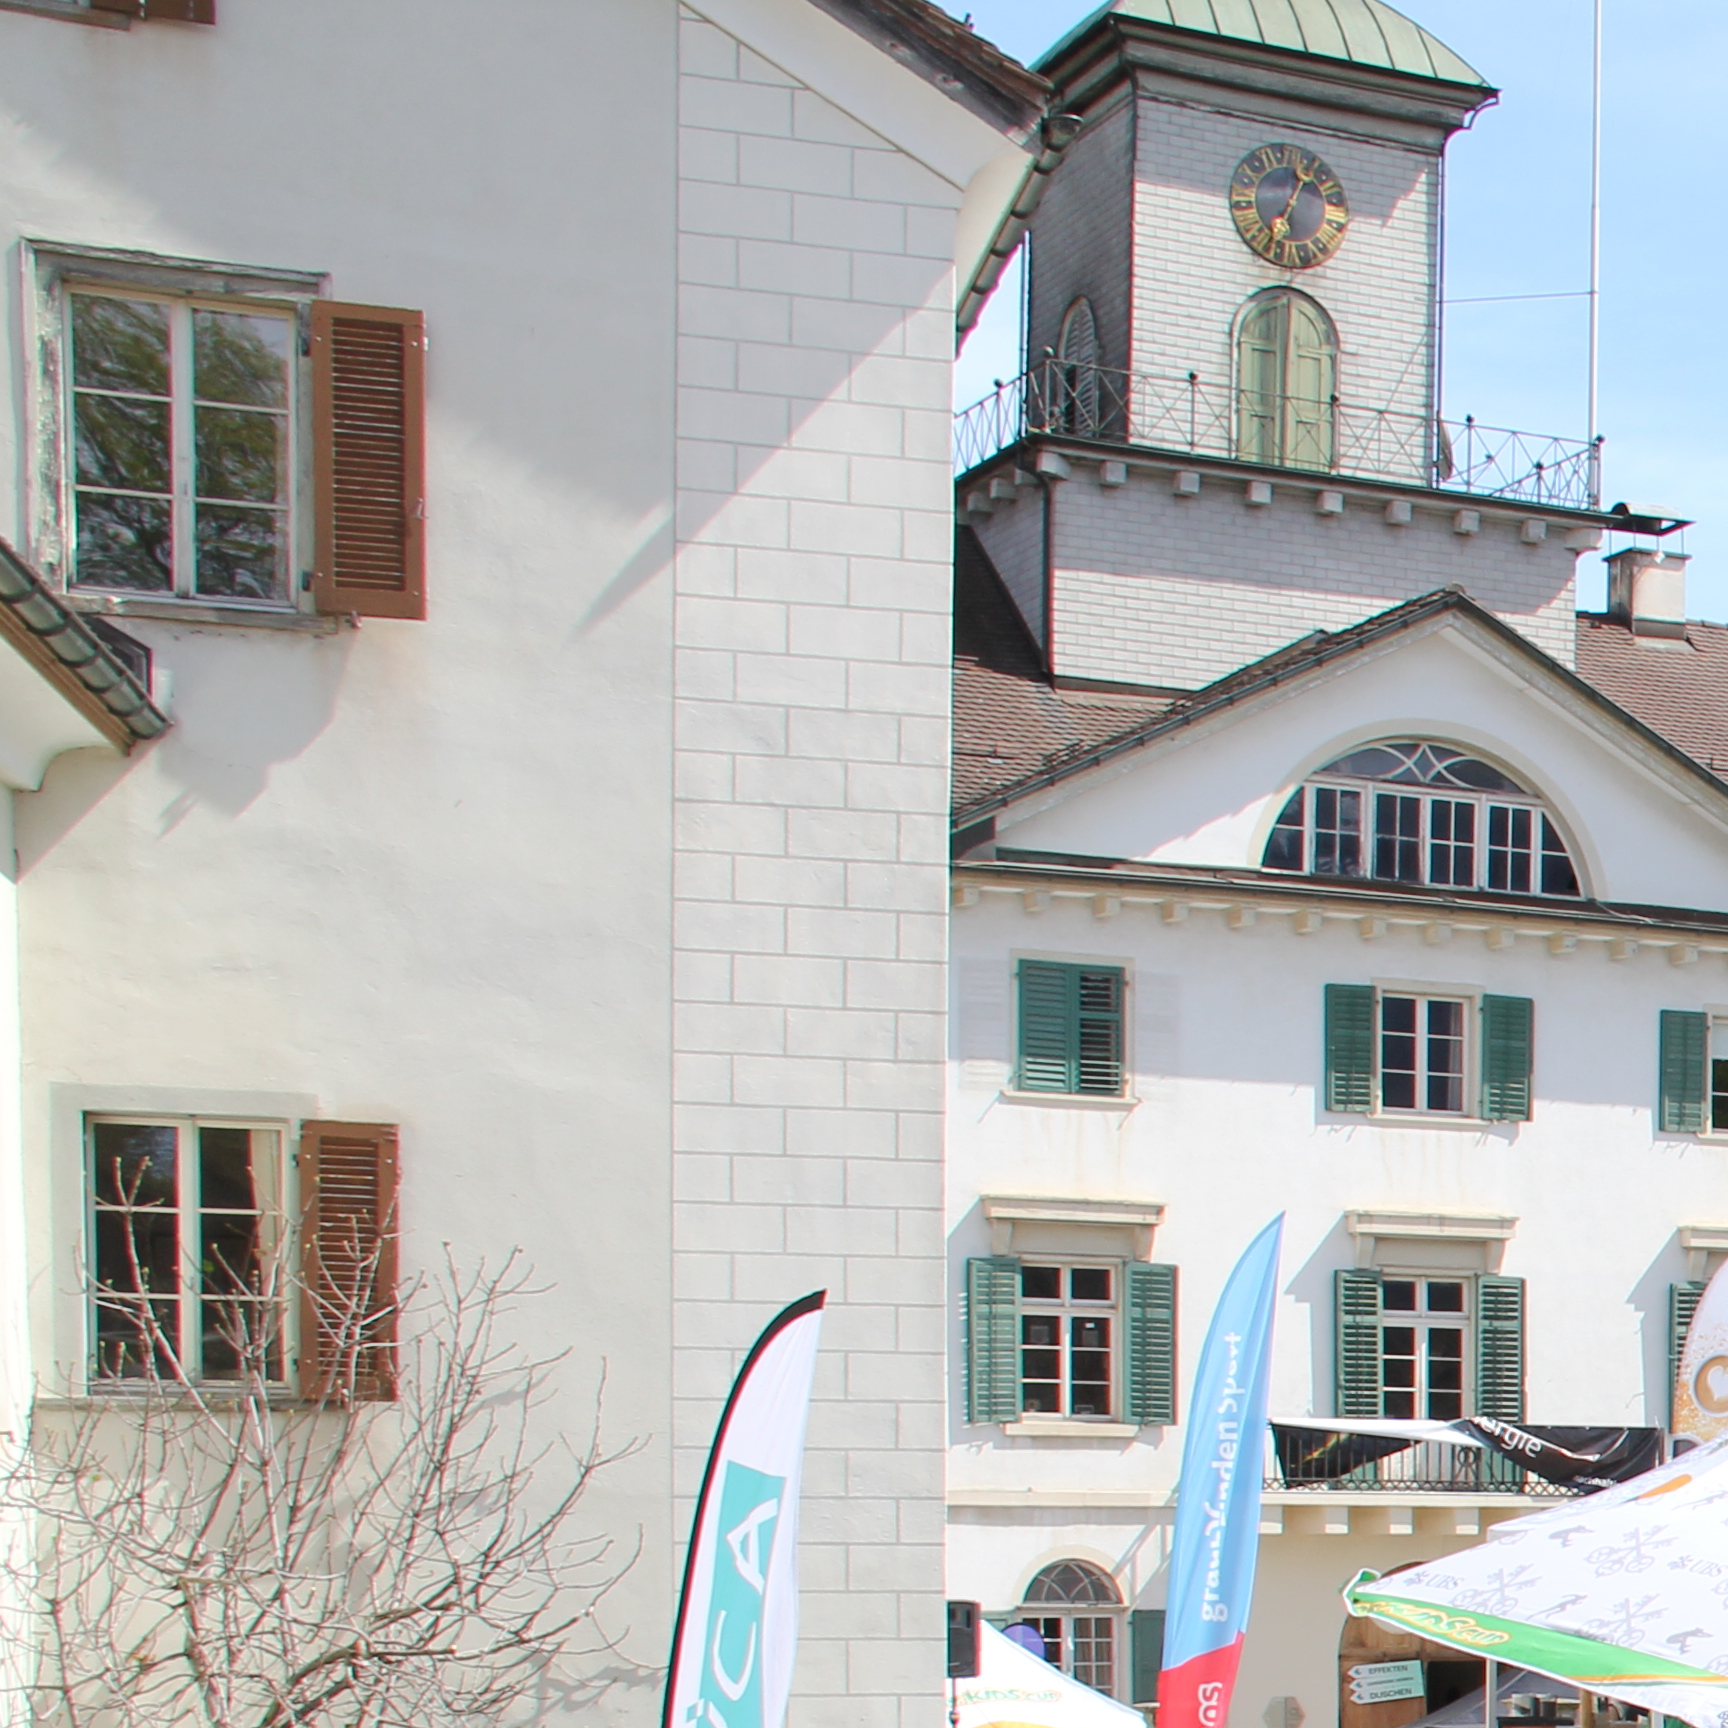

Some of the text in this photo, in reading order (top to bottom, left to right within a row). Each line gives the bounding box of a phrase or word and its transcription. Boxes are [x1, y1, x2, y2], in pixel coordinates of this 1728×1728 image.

[1475, 1416, 1542, 1459] ergie
[1368, 1665, 1408, 1675] EFFEKTEN
[1369, 1687, 1413, 1700] DUSCHEN
